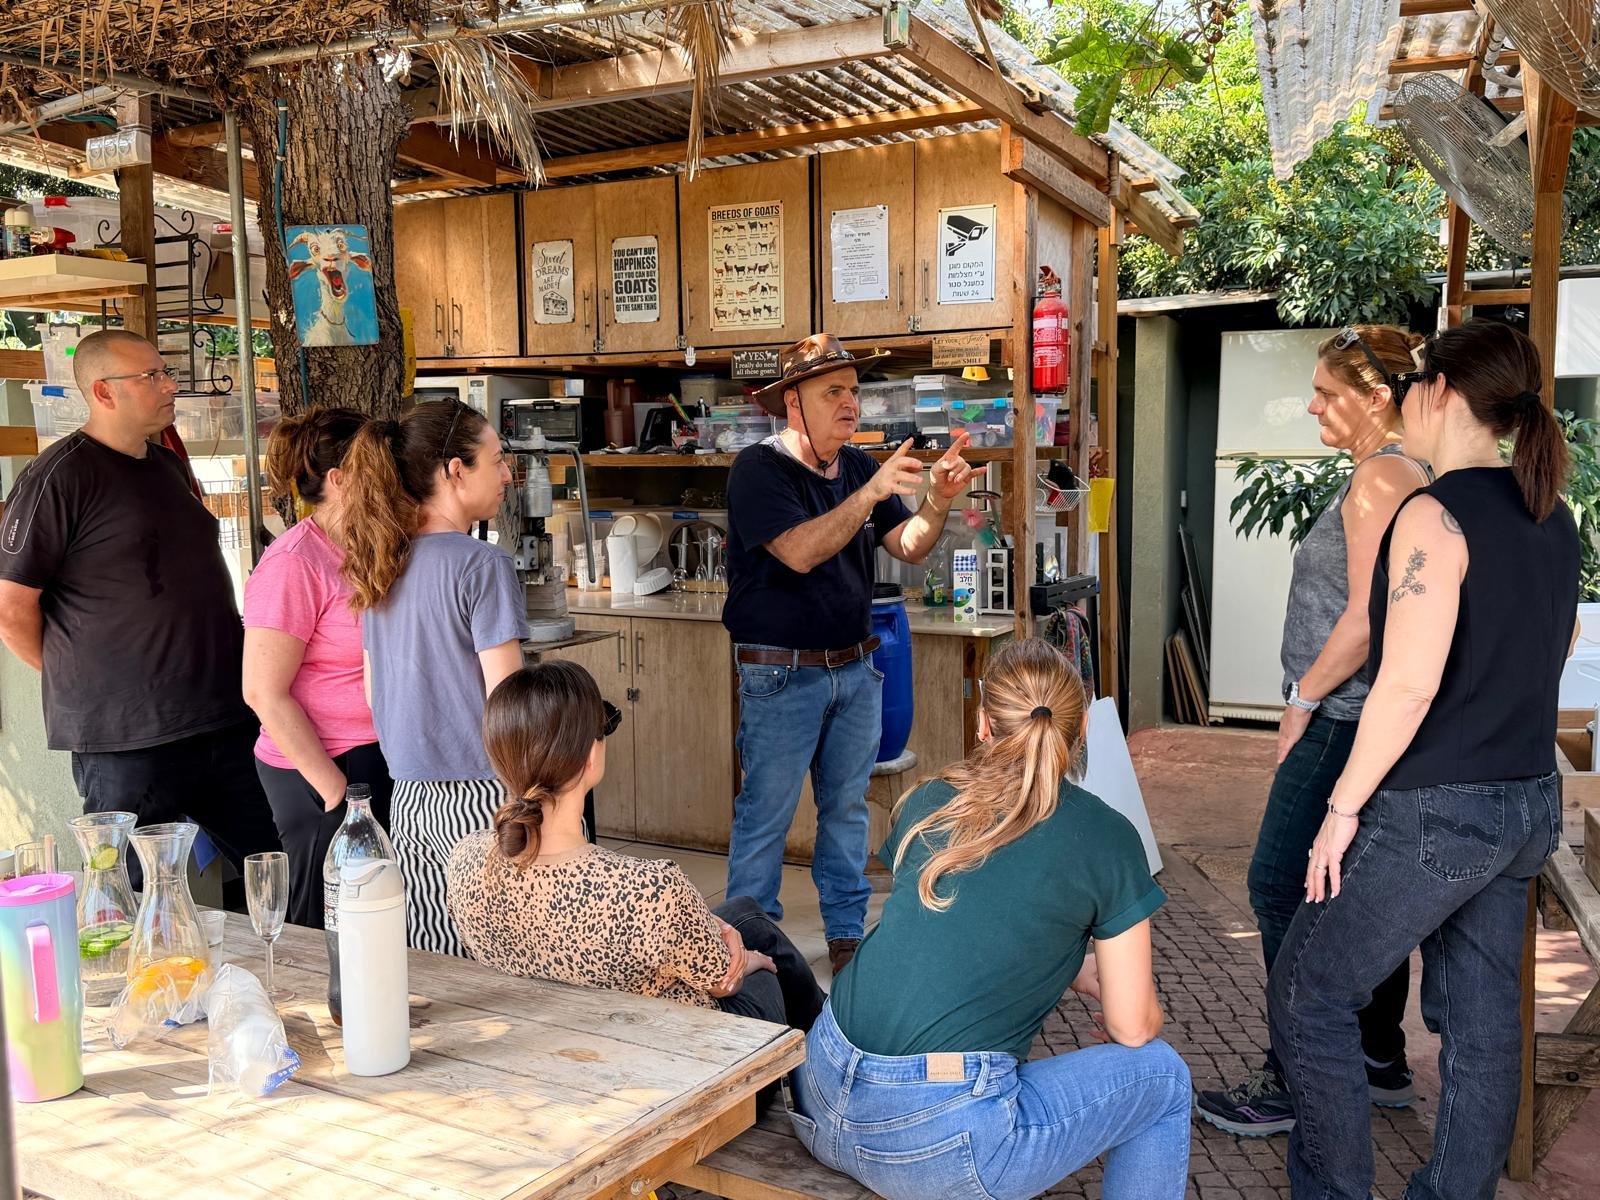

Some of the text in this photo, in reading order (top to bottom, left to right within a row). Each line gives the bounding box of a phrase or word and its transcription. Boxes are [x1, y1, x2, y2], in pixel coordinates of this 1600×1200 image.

[712, 205, 780, 220] BREEDS OF GOATS
[538, 248, 566, 267] Sweet
[614, 247, 656, 257] YOU CAN'T BUY
[614, 256, 656, 271] HAPPINESS
[535, 266, 570, 278] DREAMS
[538, 282, 554, 292] MADE
[614, 278, 656, 294] GOATS
[748, 352, 766, 361] YES,
